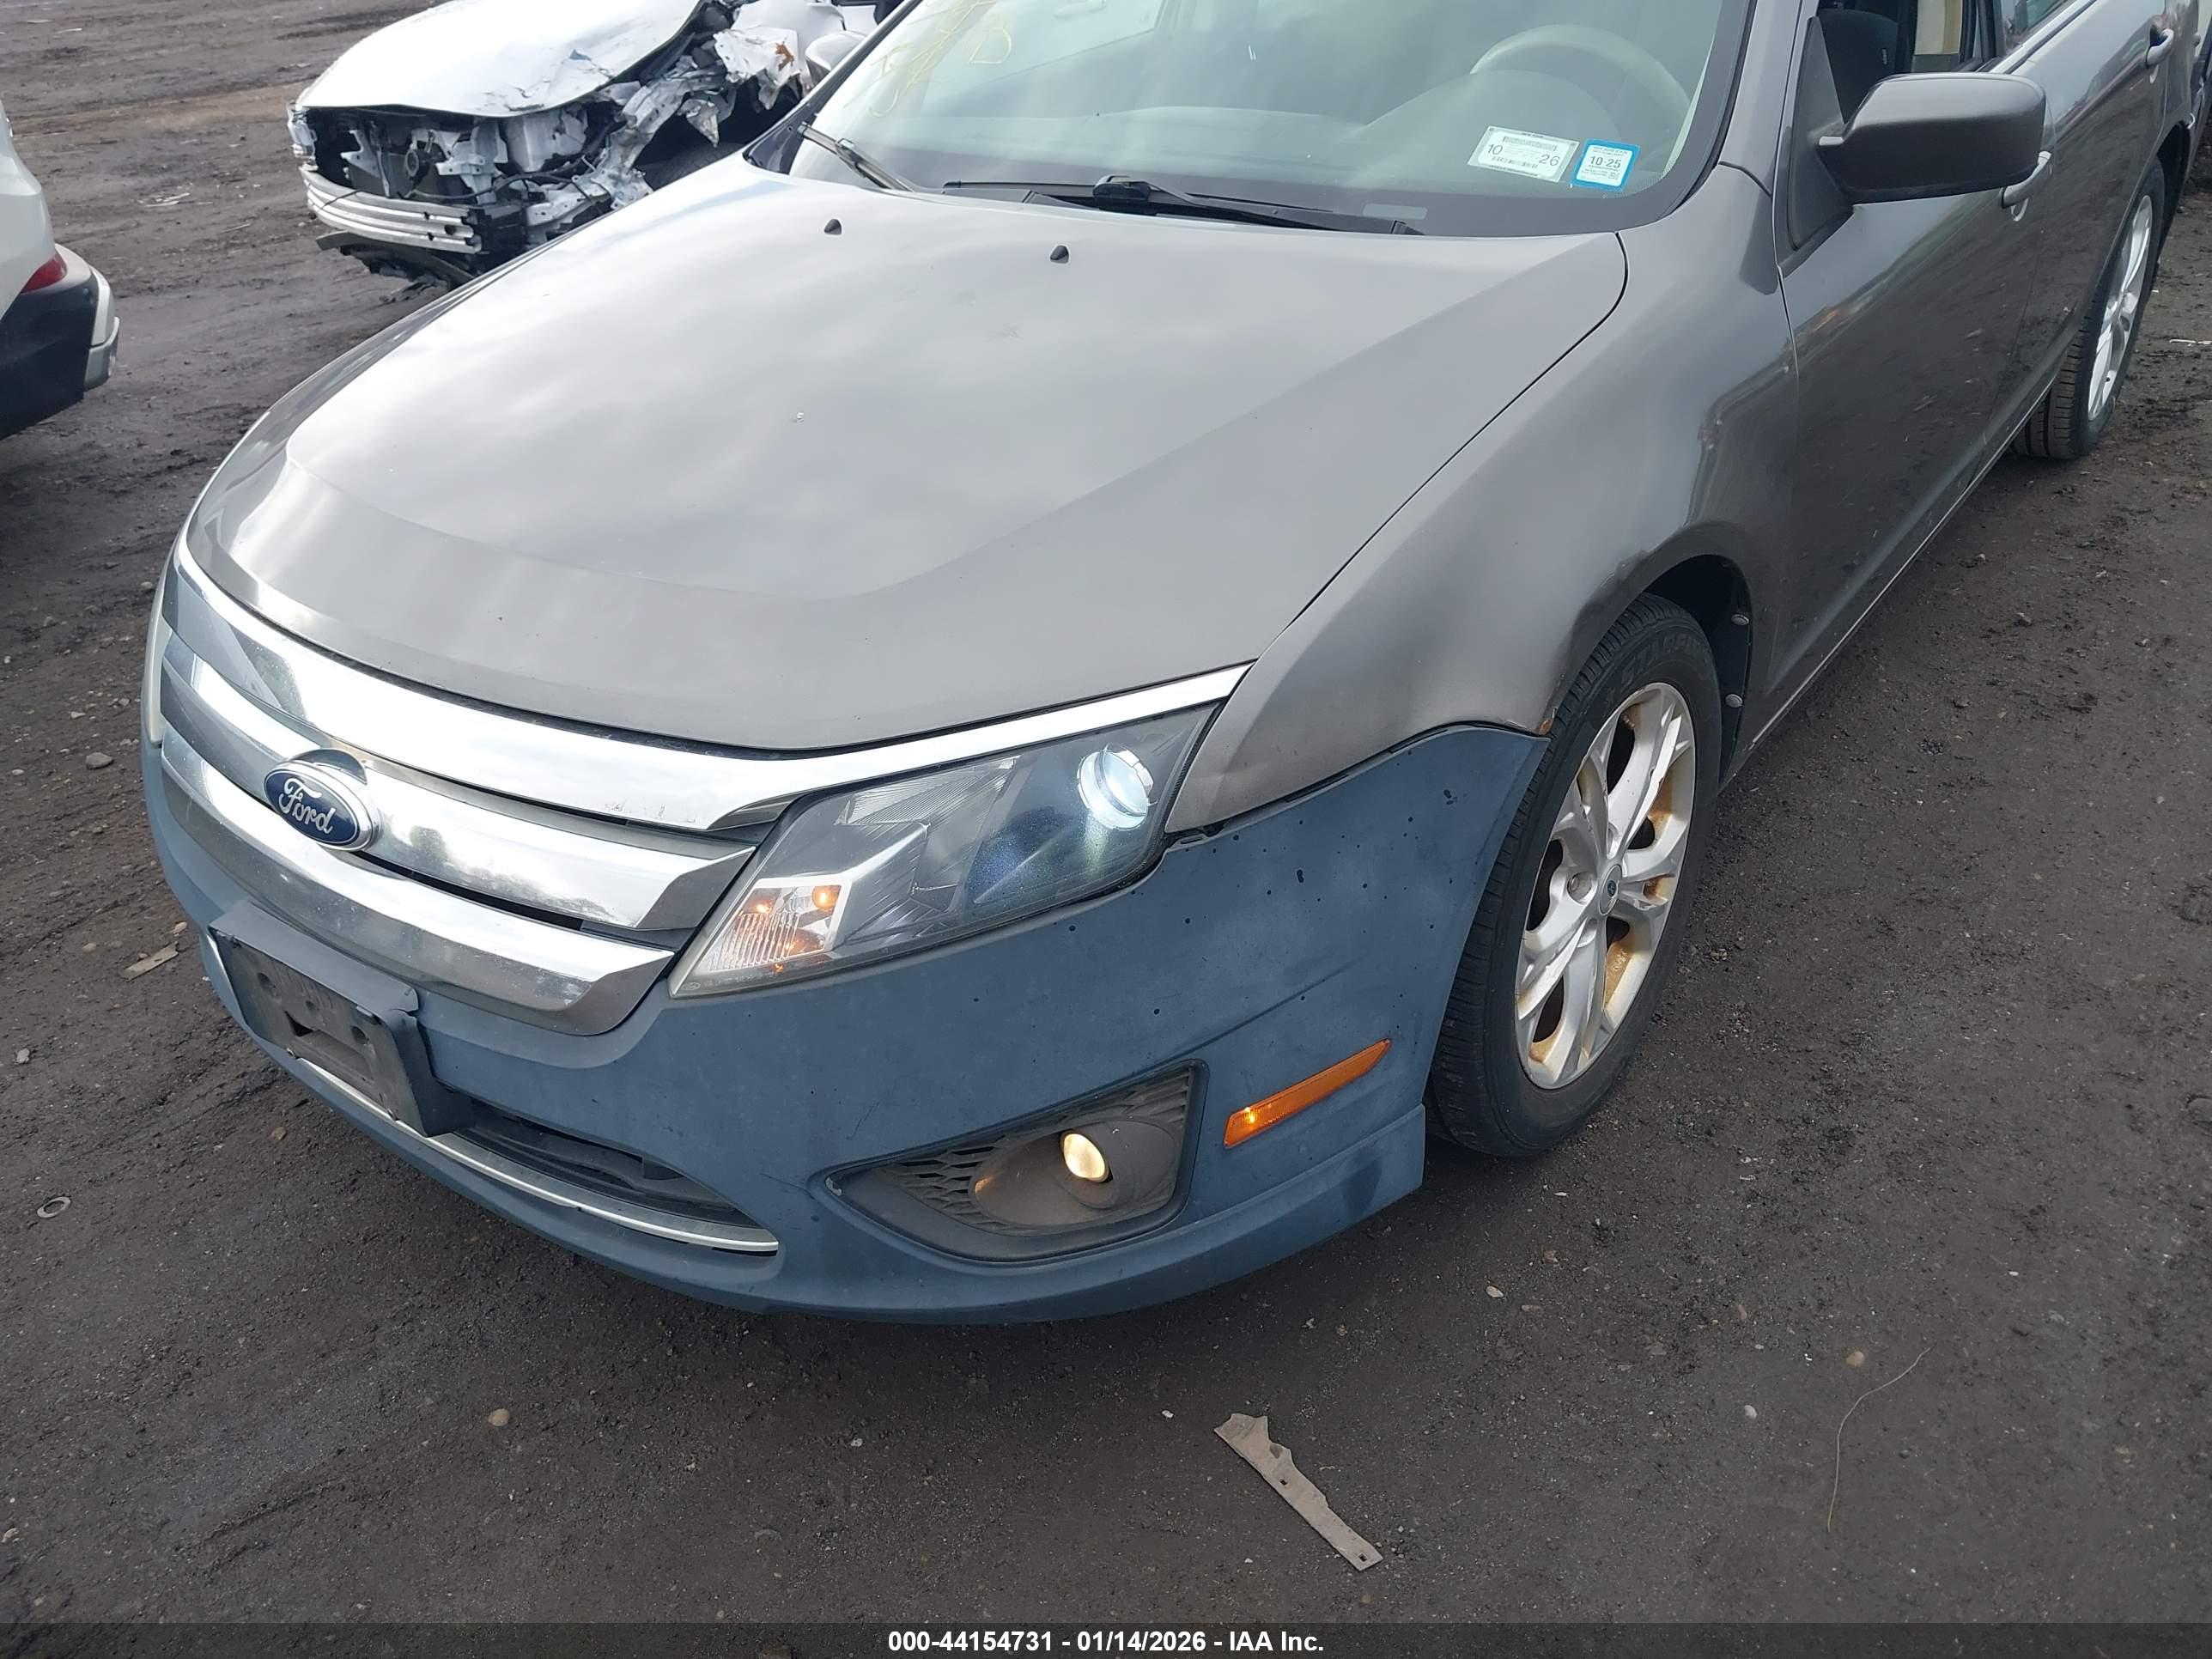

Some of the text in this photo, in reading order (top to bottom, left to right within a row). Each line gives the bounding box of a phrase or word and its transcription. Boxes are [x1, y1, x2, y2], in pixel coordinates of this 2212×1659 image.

[1487, 143, 1504, 155] 10
[1538, 153, 1560, 167] 26
[278, 777, 337, 835] Ford
